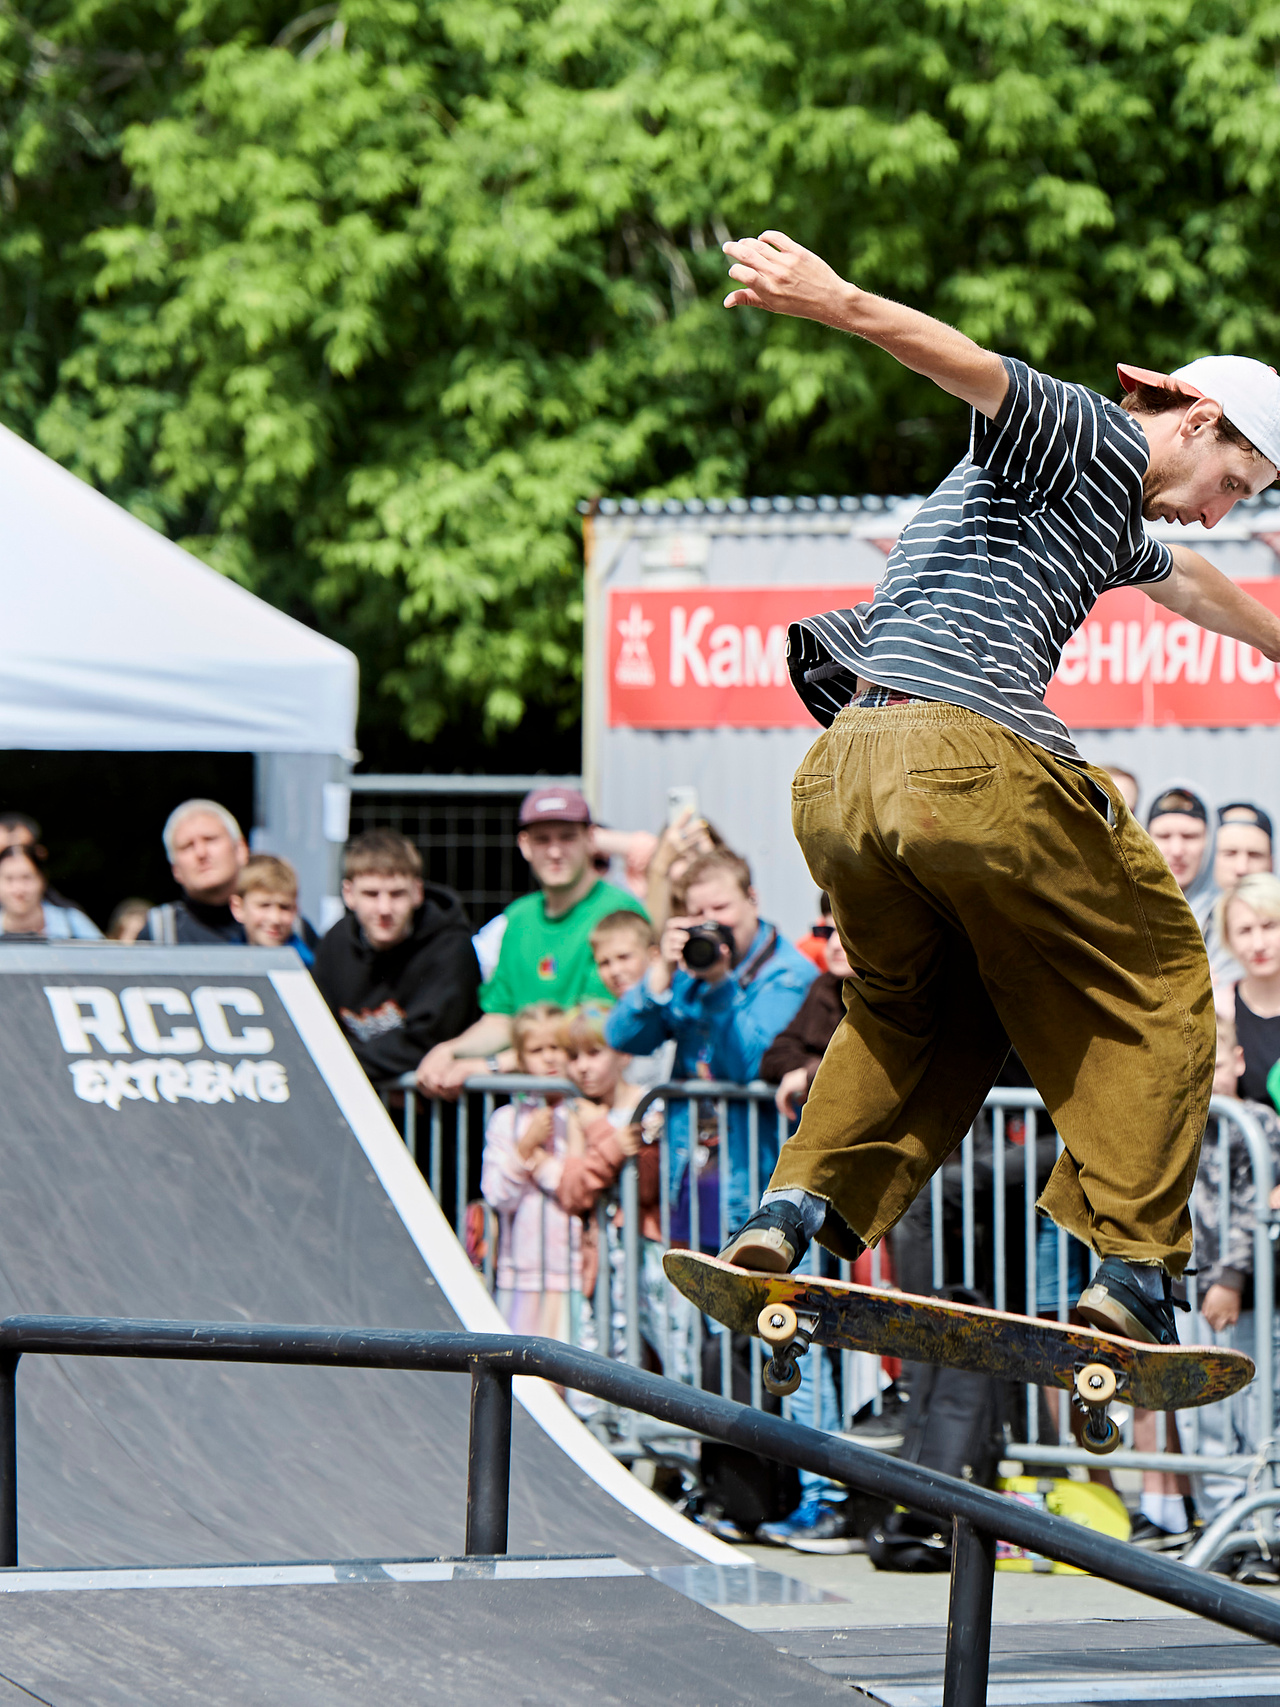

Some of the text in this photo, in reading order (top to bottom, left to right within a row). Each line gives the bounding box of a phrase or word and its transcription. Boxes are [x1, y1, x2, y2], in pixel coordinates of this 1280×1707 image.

[669, 605, 788, 688] Кам
[43, 986, 275, 1054] RCC
[68, 1058, 290, 1111] EXTREME
